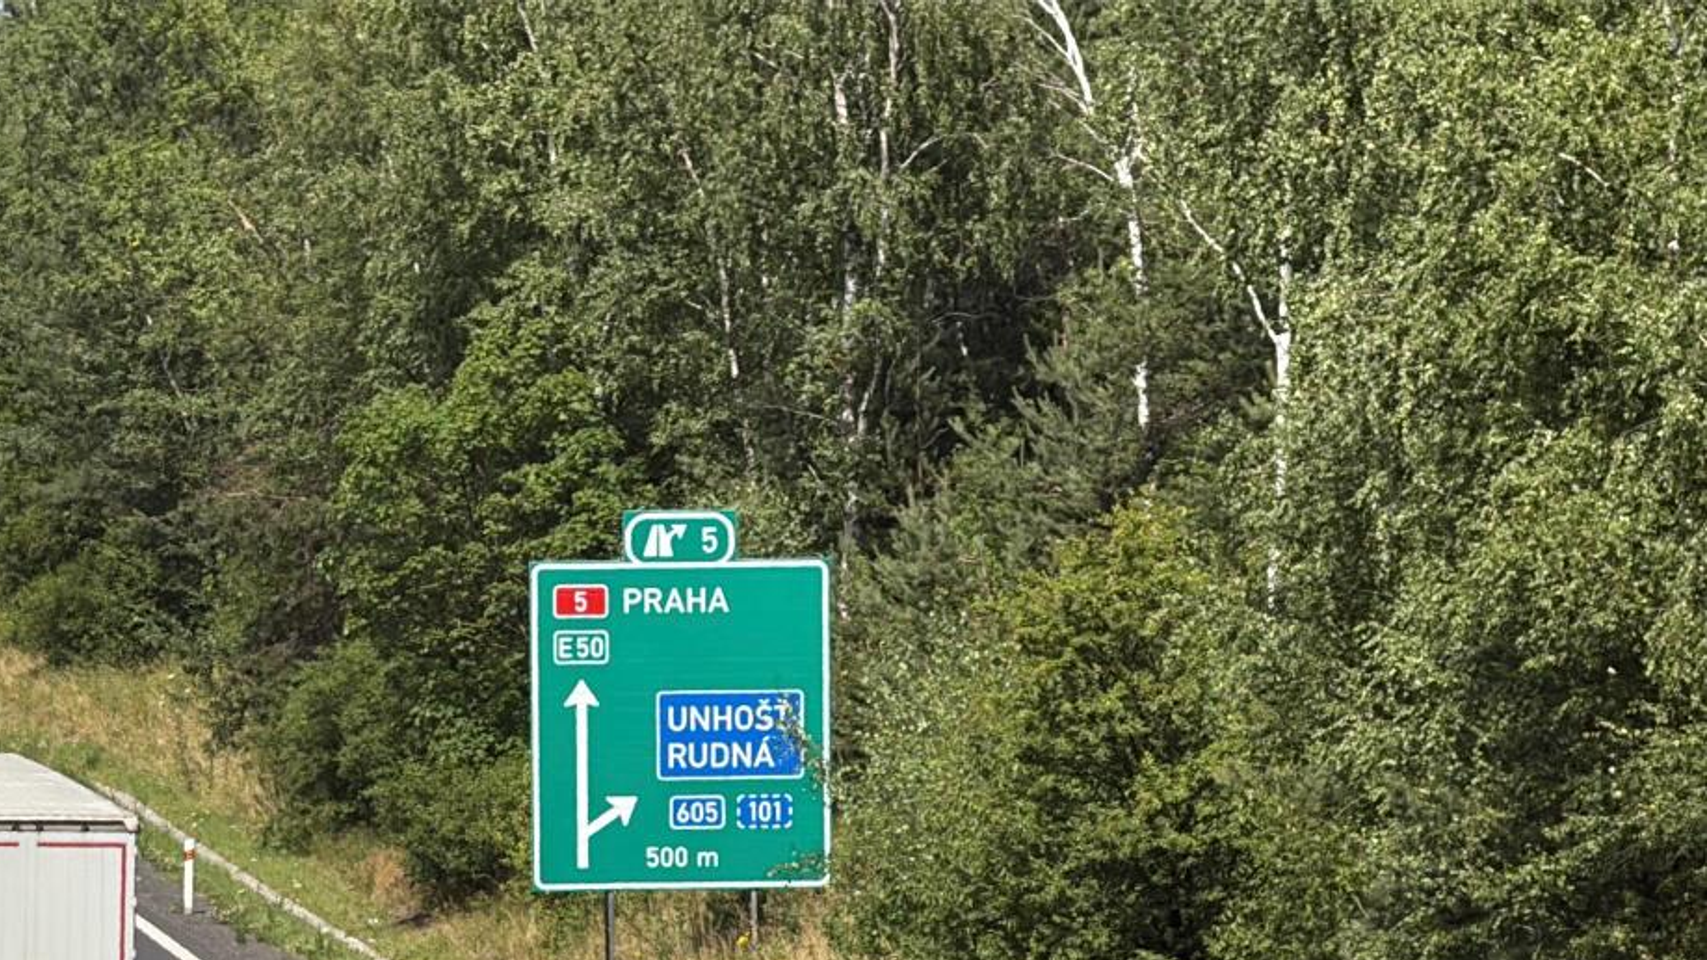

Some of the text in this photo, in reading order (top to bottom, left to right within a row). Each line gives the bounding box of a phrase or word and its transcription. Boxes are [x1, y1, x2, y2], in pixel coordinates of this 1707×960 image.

[702, 528, 718, 553] 5
[573, 587, 730, 614] 5 PRAHA
[667, 735, 775, 768] RUDNÁ
[676, 801, 782, 823] 605 101
[646, 846, 719, 867] 500 m
